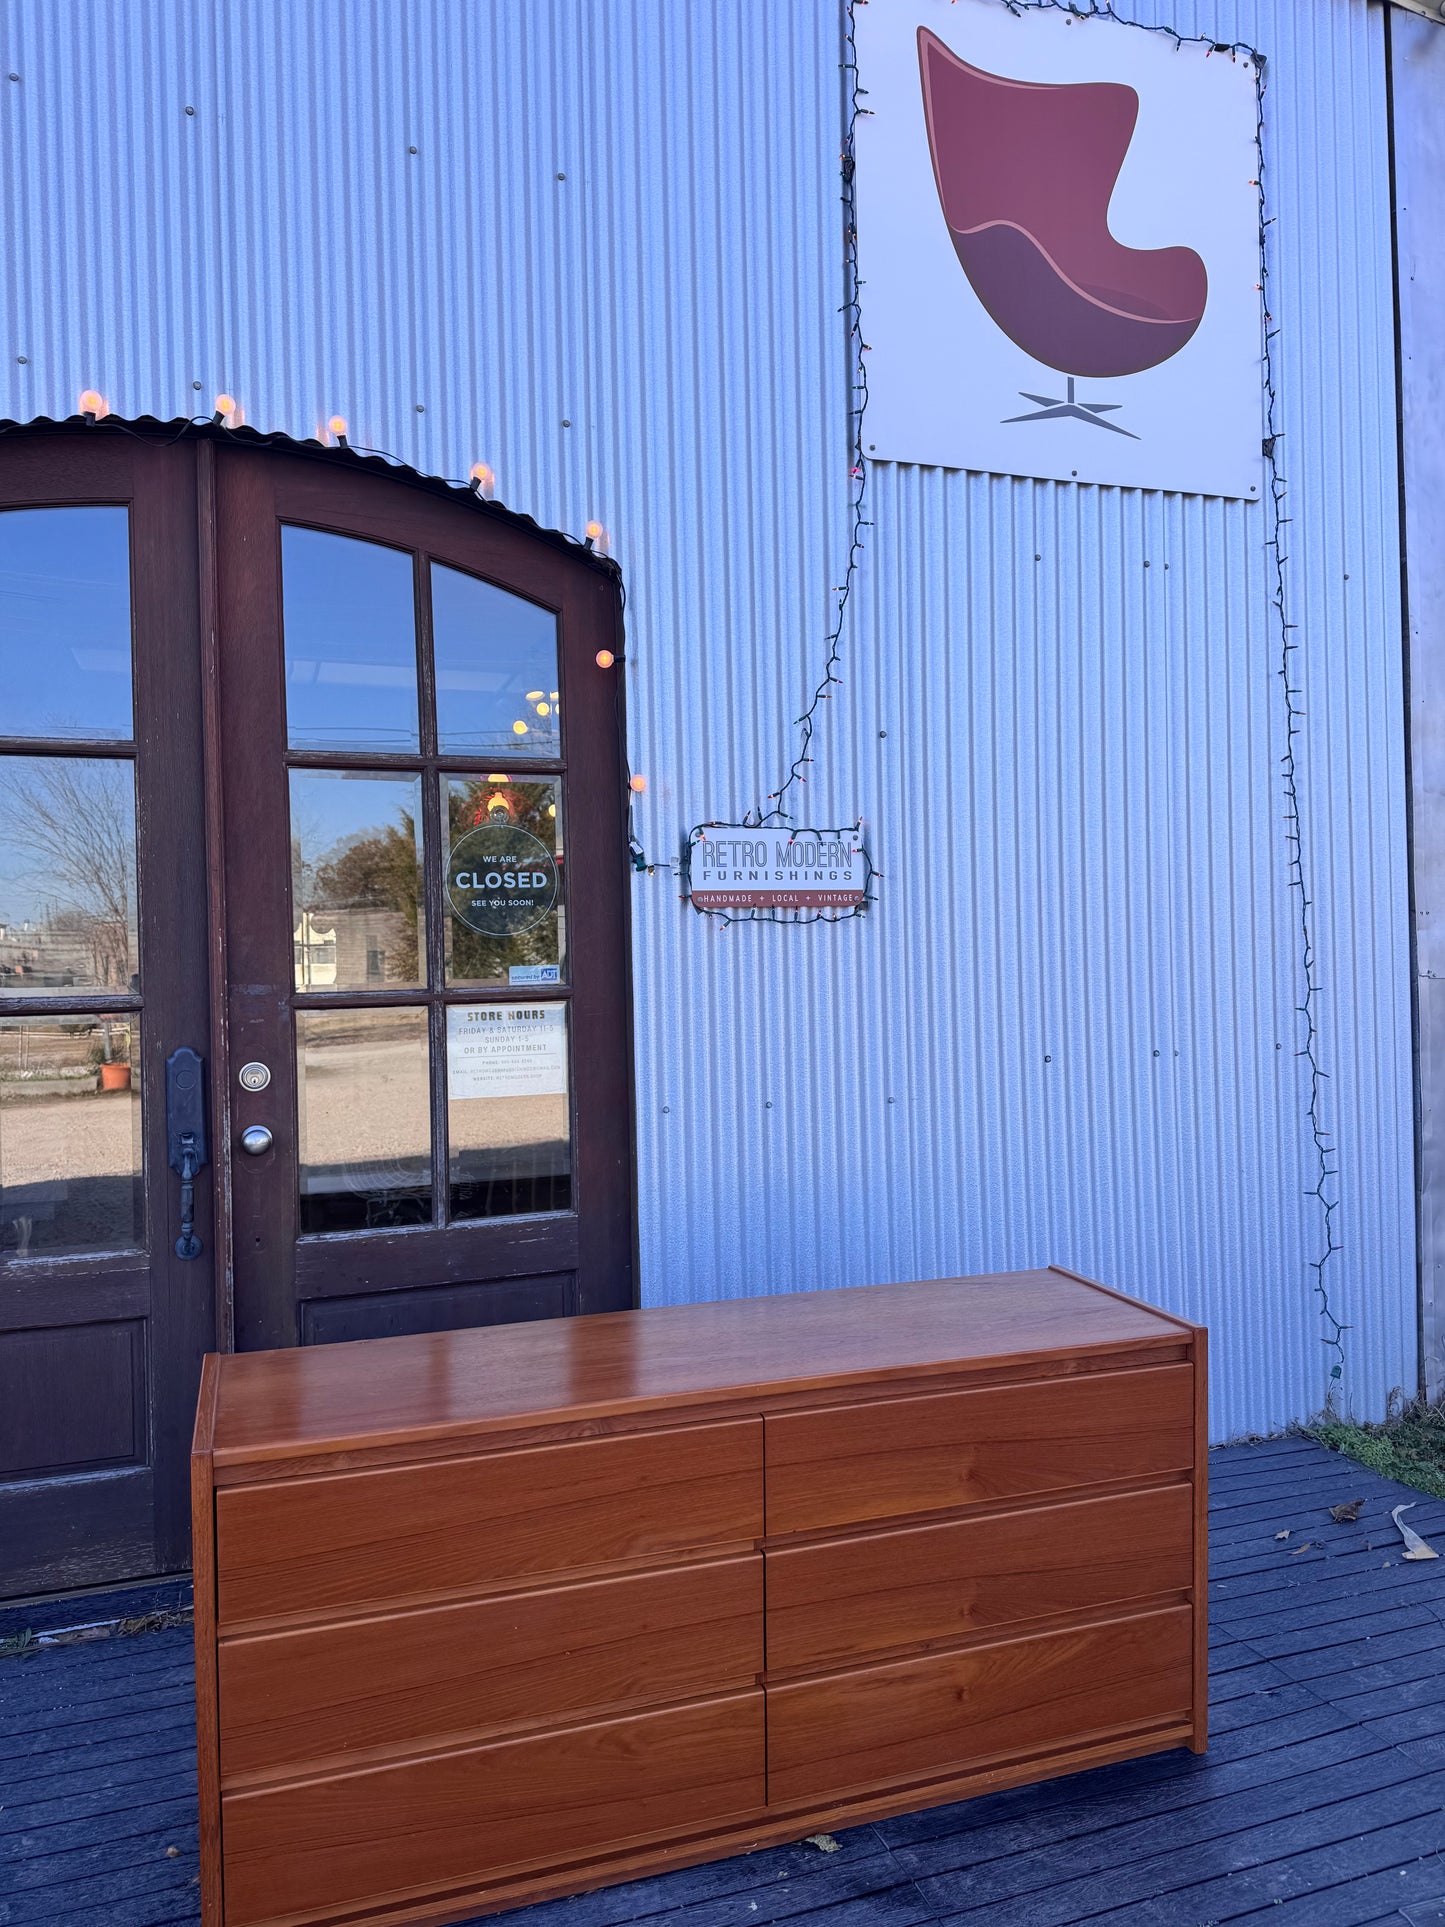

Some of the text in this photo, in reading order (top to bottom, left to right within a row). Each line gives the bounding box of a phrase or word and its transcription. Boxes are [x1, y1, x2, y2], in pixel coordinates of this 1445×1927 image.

[702, 840, 851, 868] RETRO MODERN
[456, 872, 547, 889] CLOSED
[703, 870, 852, 881] FURNISHINGS
[703, 894, 752, 903] HANDMADE
[541, 970, 557, 979] ADT
[468, 1010, 545, 1021] STORE HOURS
[459, 1027, 486, 1035] FRIDAY
[497, 1025, 537, 1033] SATURDAY
[485, 1035, 515, 1043] SUNDAY
[491, 1044, 547, 1053] APPOINTMENT
